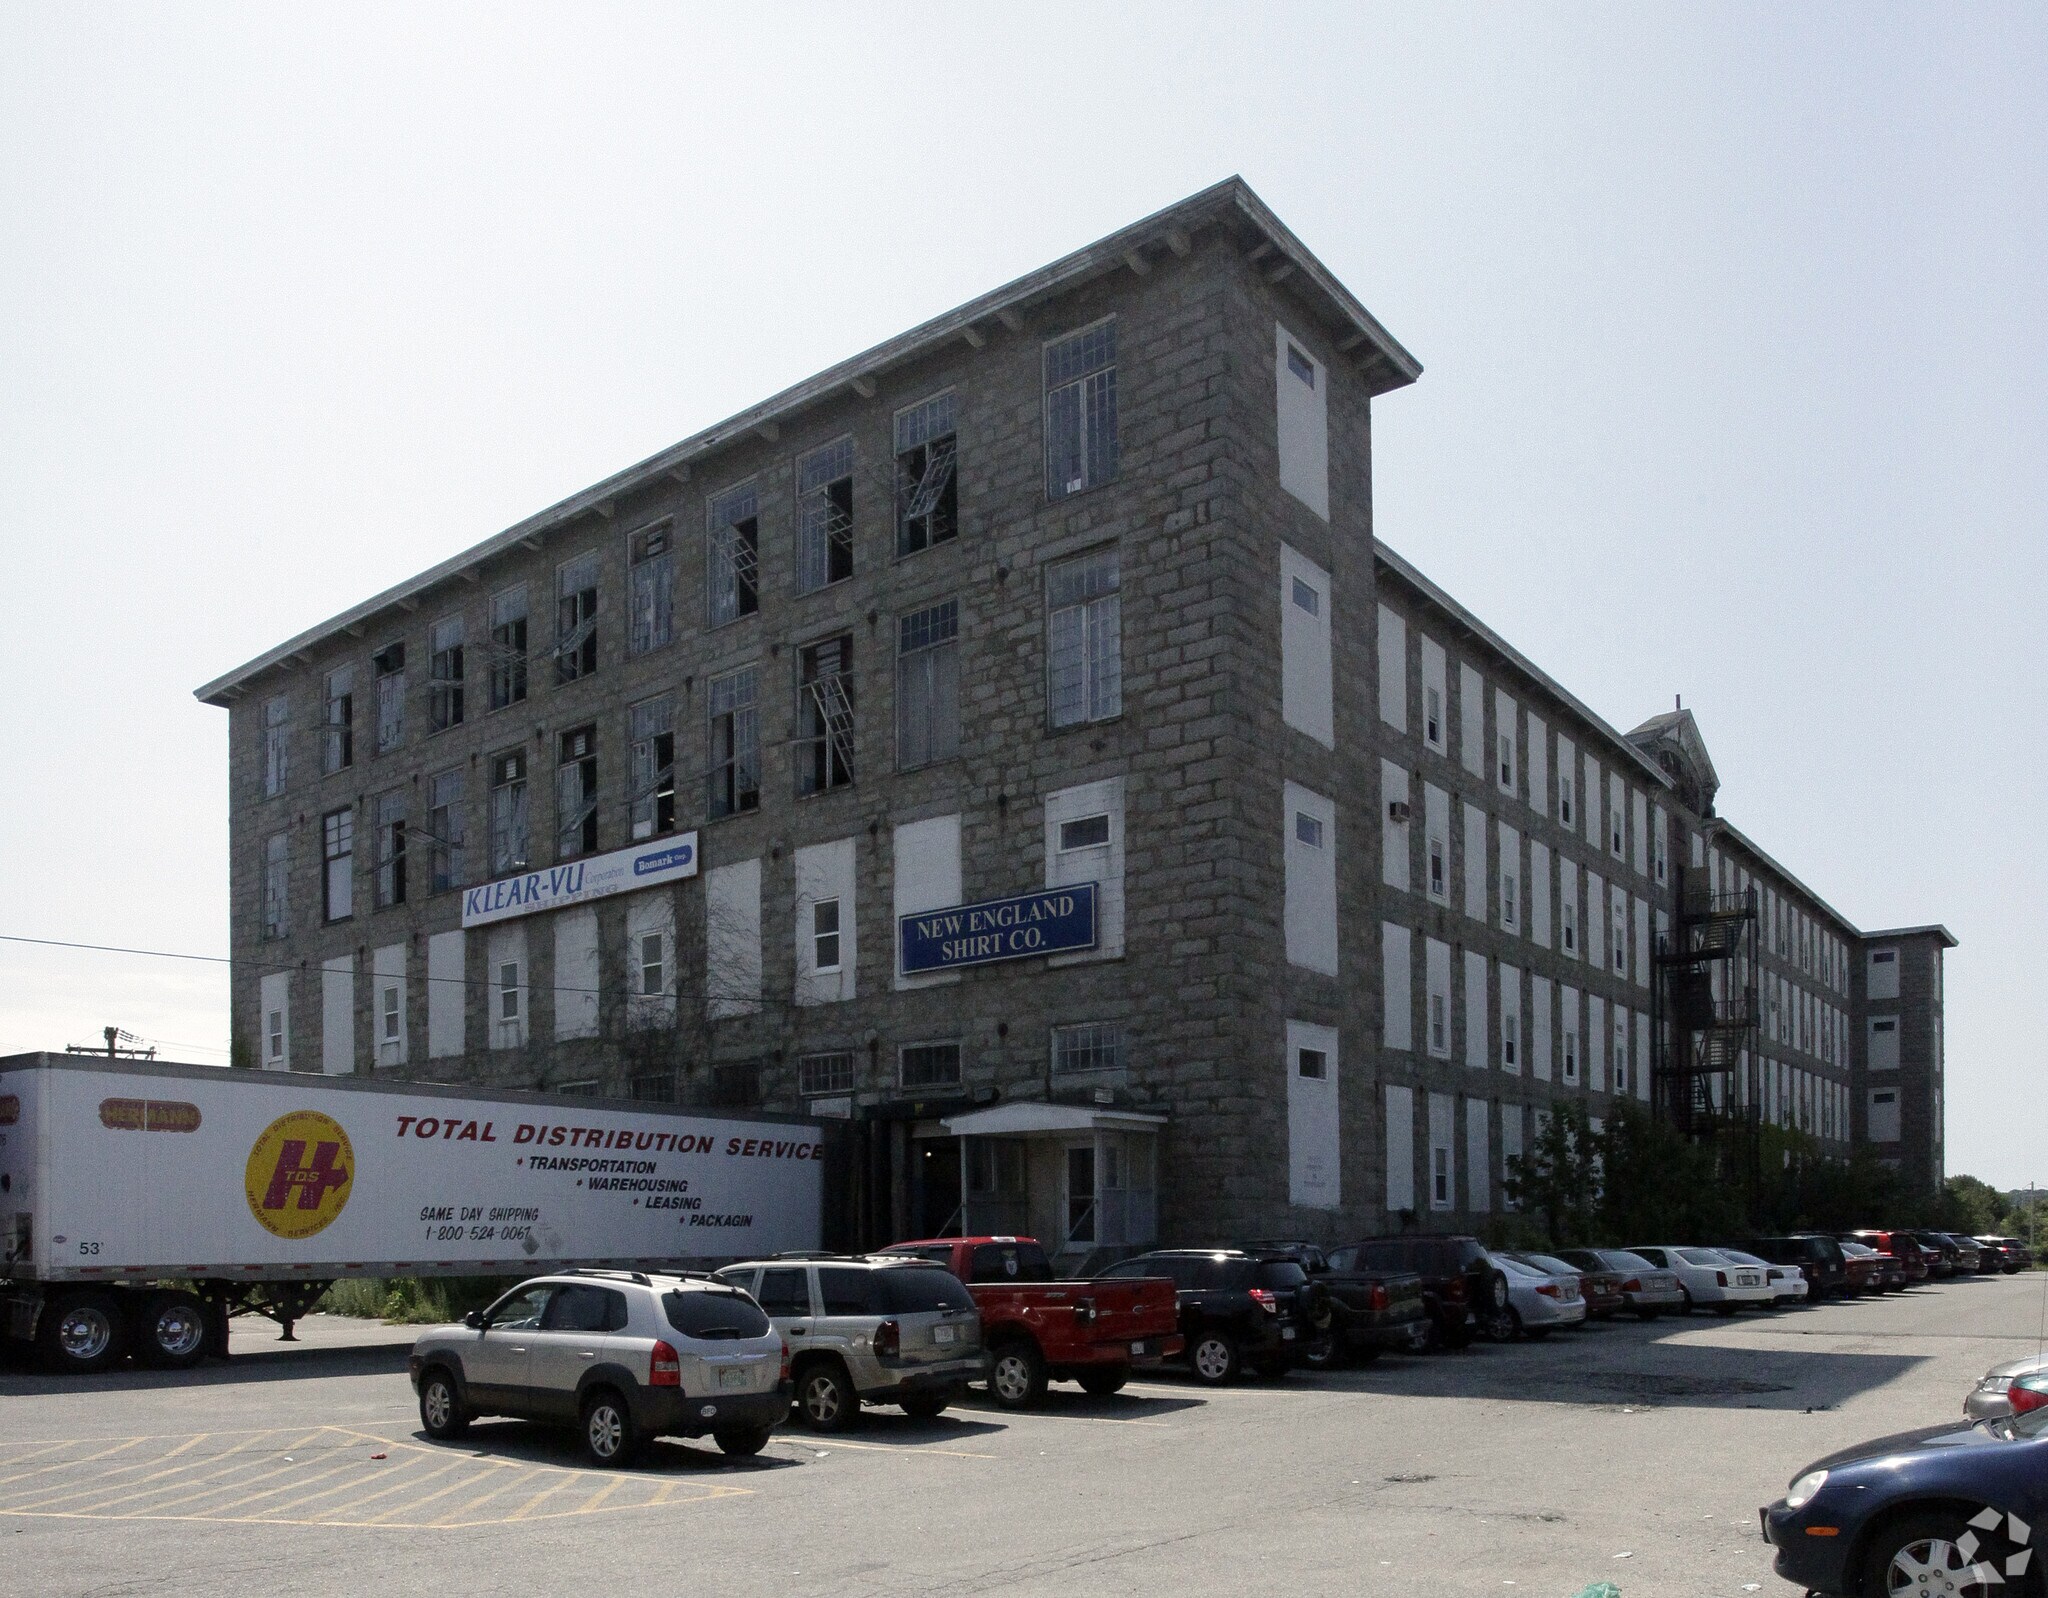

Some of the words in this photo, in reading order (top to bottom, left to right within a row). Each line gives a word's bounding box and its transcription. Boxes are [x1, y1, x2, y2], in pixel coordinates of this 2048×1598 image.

[639, 855, 673, 871] Bomark
[466, 863, 584, 916] KLEAR-VU
[917, 914, 964, 940] NEW
[970, 896, 1074, 932] ENGLAND
[942, 933, 1003, 961] SHIRT
[1009, 927, 1046, 950] CO.
[397, 1116, 497, 1142] TOTAL
[513, 1124, 714, 1153] DISTRIBUTION
[726, 1137, 823, 1160] SERVICE
[529, 1156, 656, 1173] TRANSPORTATION
[285, 1170, 320, 1182] TDS
[588, 1178, 688, 1192] WAREHOUSING
[645, 1197, 701, 1210] LEASING
[420, 1207, 453, 1221] SAME
[460, 1207, 483, 1221] DAY
[489, 1207, 539, 1221] SHIPPING
[689, 1215, 752, 1227] PACKAGIN
[426, 1226, 531, 1241] 1-800-524-0067
